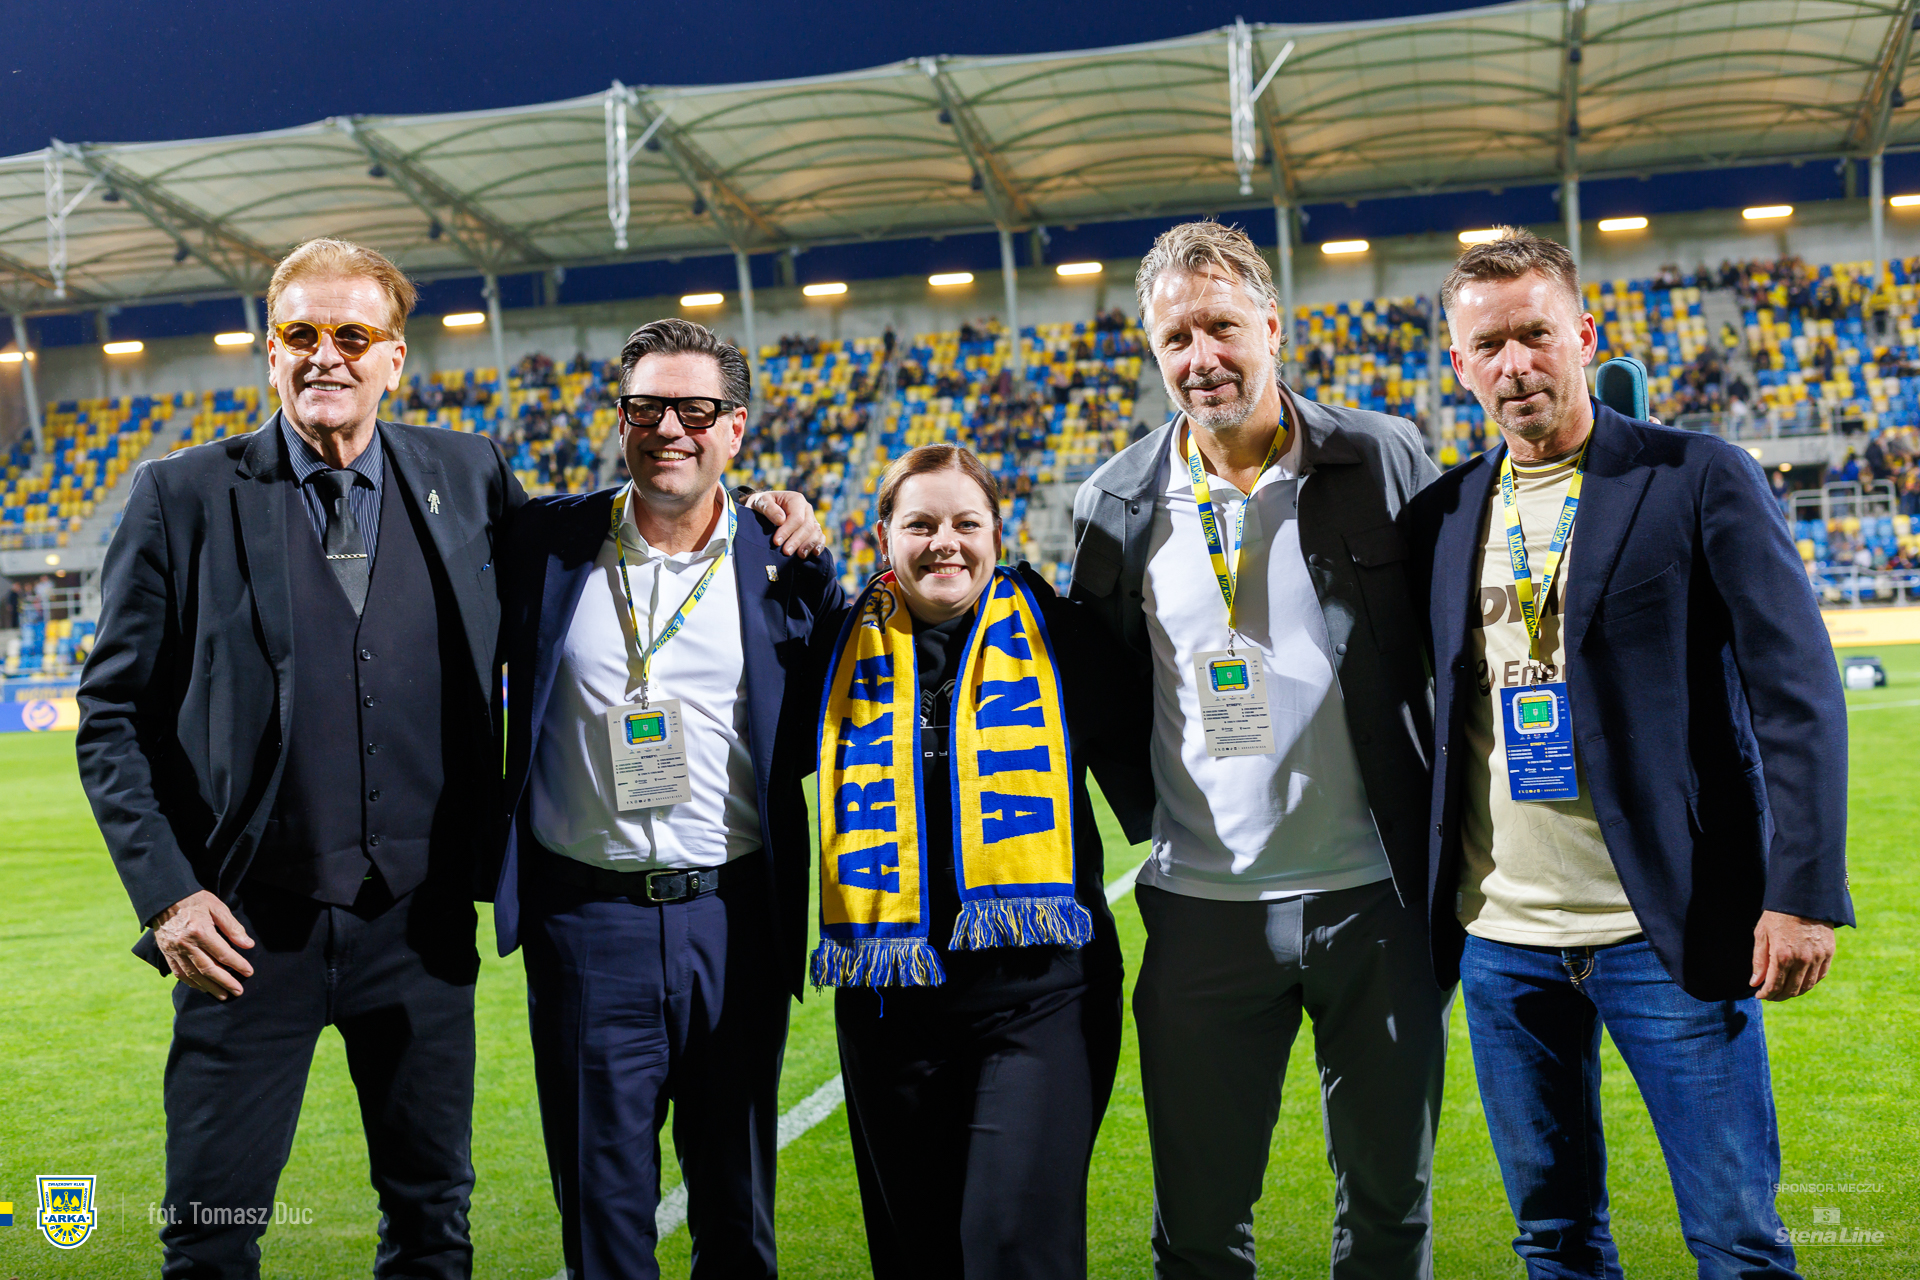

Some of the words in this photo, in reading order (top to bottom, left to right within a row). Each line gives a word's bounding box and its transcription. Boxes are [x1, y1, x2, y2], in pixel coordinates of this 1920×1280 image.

[1502, 472, 1513, 494] MZKS
[1200, 510, 1216, 535] MZKS
[1558, 505, 1577, 532] MZKS
[1508, 533, 1524, 559] MZKS
[693, 579, 710, 602] MZKS
[1217, 574, 1229, 599] MZKS
[1521, 601, 1536, 626] MZKS
[655, 628, 675, 650] MZKS
[834, 652, 901, 894] ARKA
